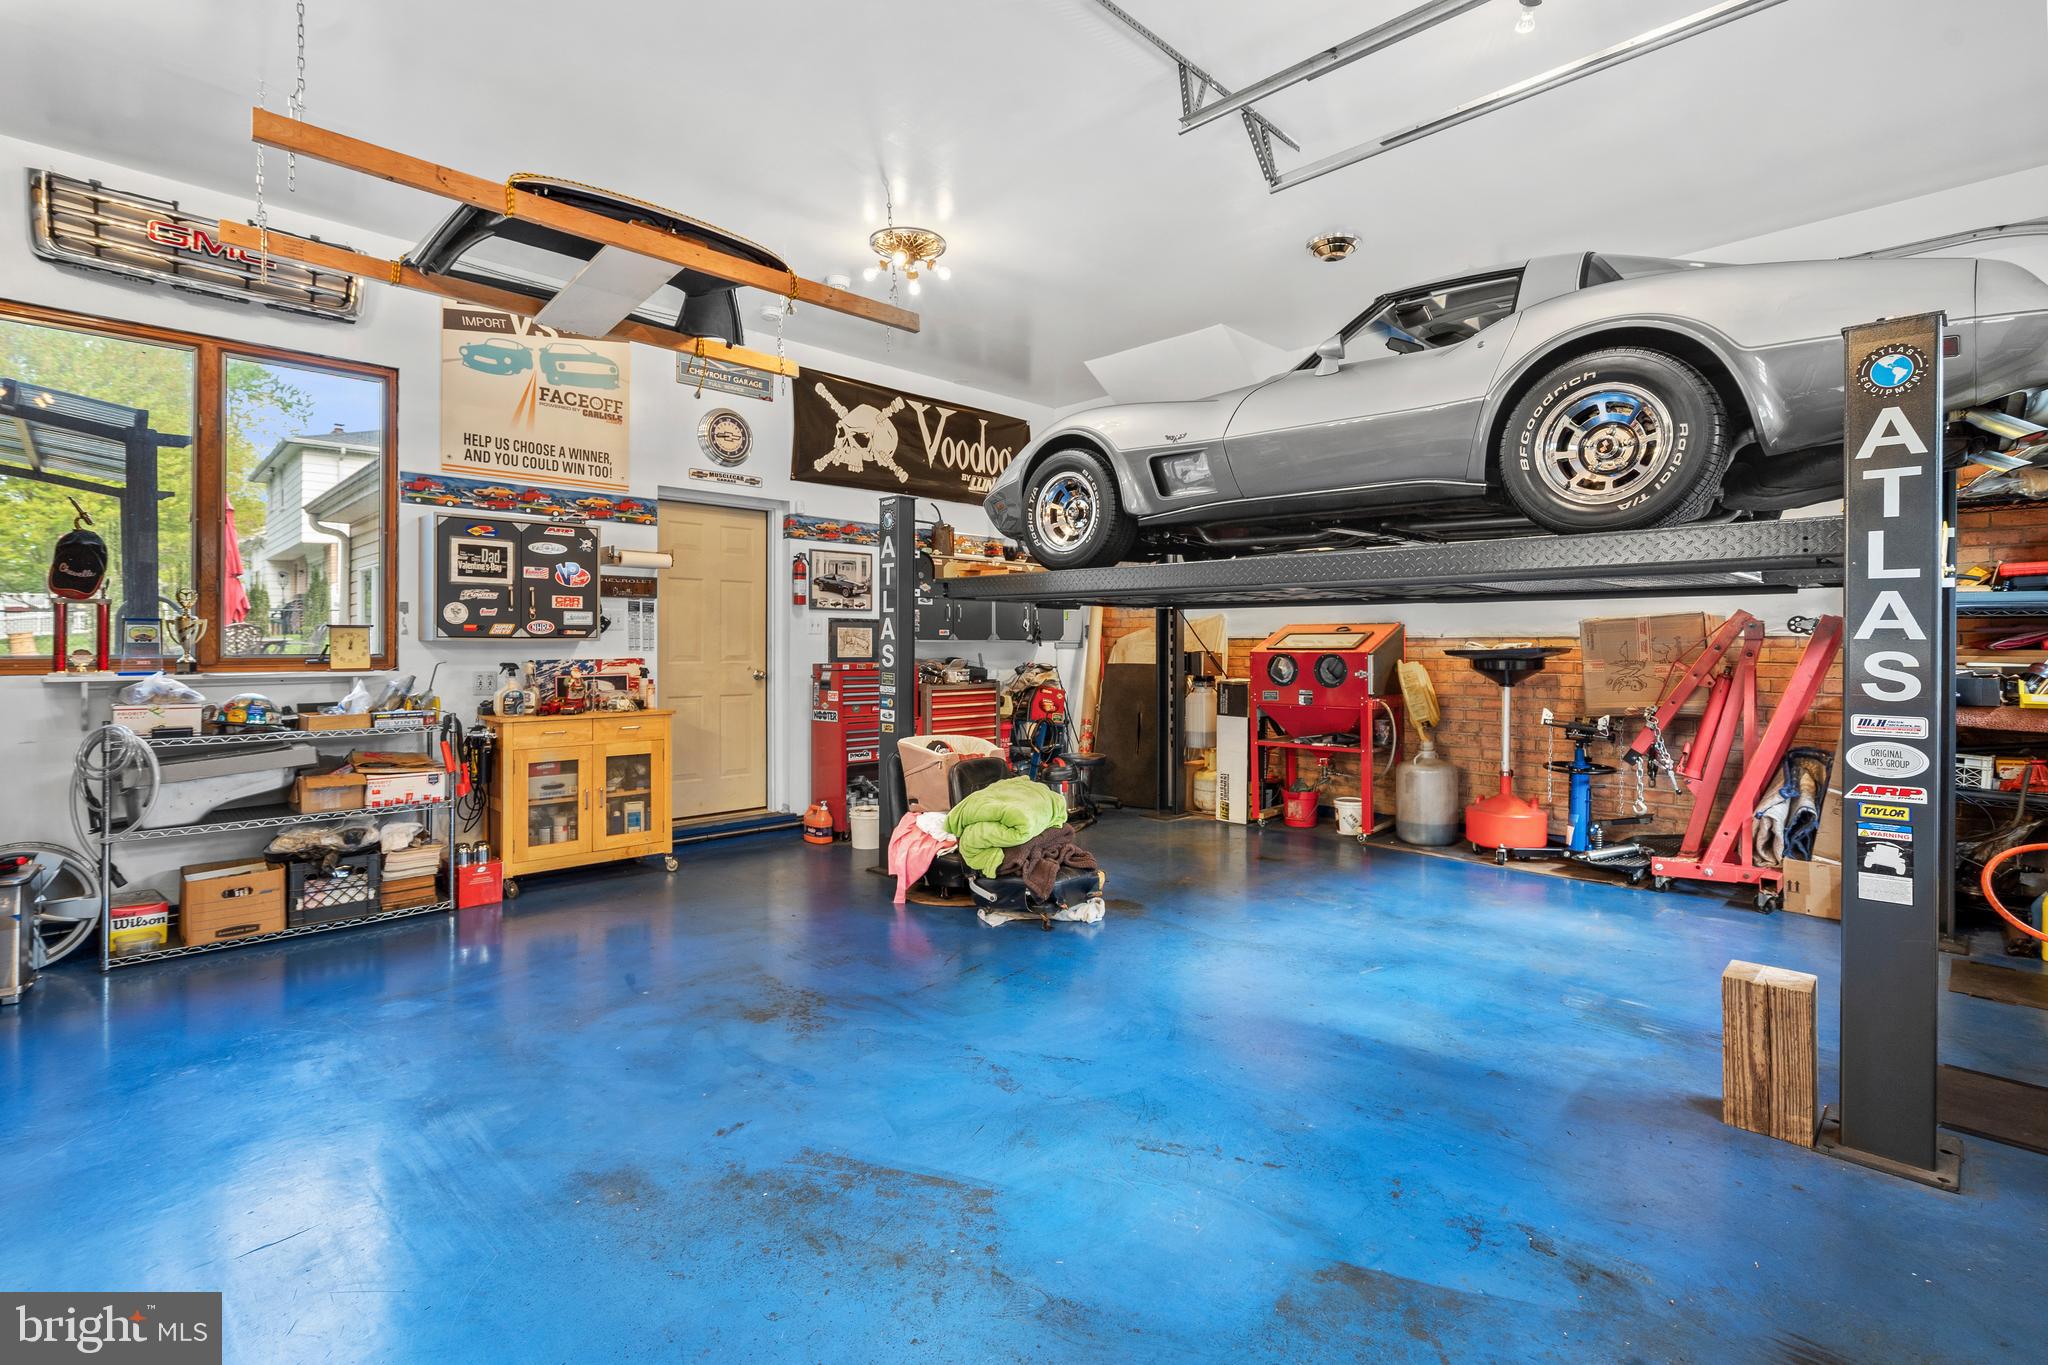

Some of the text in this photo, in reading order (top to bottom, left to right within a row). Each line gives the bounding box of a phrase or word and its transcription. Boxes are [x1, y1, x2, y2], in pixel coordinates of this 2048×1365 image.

[462, 316, 507, 329] IMPORT
[1871, 346, 1915, 362] ATLAS
[689, 367, 763, 388] CHEVROLET GARAGE
[1860, 369, 1924, 396] EQUIPMENT
[538, 386, 623, 414] FACEOFF
[582, 409, 623, 421] CARLISLE
[1520, 371, 1598, 471] BFGoodrich
[905, 399, 1012, 475] Voodoo
[463, 432, 613, 466] HELP US CHOOSE A WINNER,
[1654, 422, 1689, 490] Radial
[464, 448, 613, 479] AND YOU COULD WIN TOO!
[961, 473, 972, 481] BY
[1029, 487, 1039, 504] T/A
[1617, 493, 1651, 511] T/A
[1027, 508, 1042, 546] Radial
[481, 548, 500, 563] Dad
[1854, 406, 1929, 702] ATLAS
[555, 562, 580, 585] VP
[880, 536, 896, 668] ATLAS
[1870, 748, 1903, 759] ORIGINAL
[1864, 757, 1910, 769] PARTS GROUP
[1851, 785, 1923, 797] ARP
[1864, 806, 1906, 818] TAYLOR
[1870, 831, 1910, 840] WARNING
[112, 916, 165, 930] Wilson
